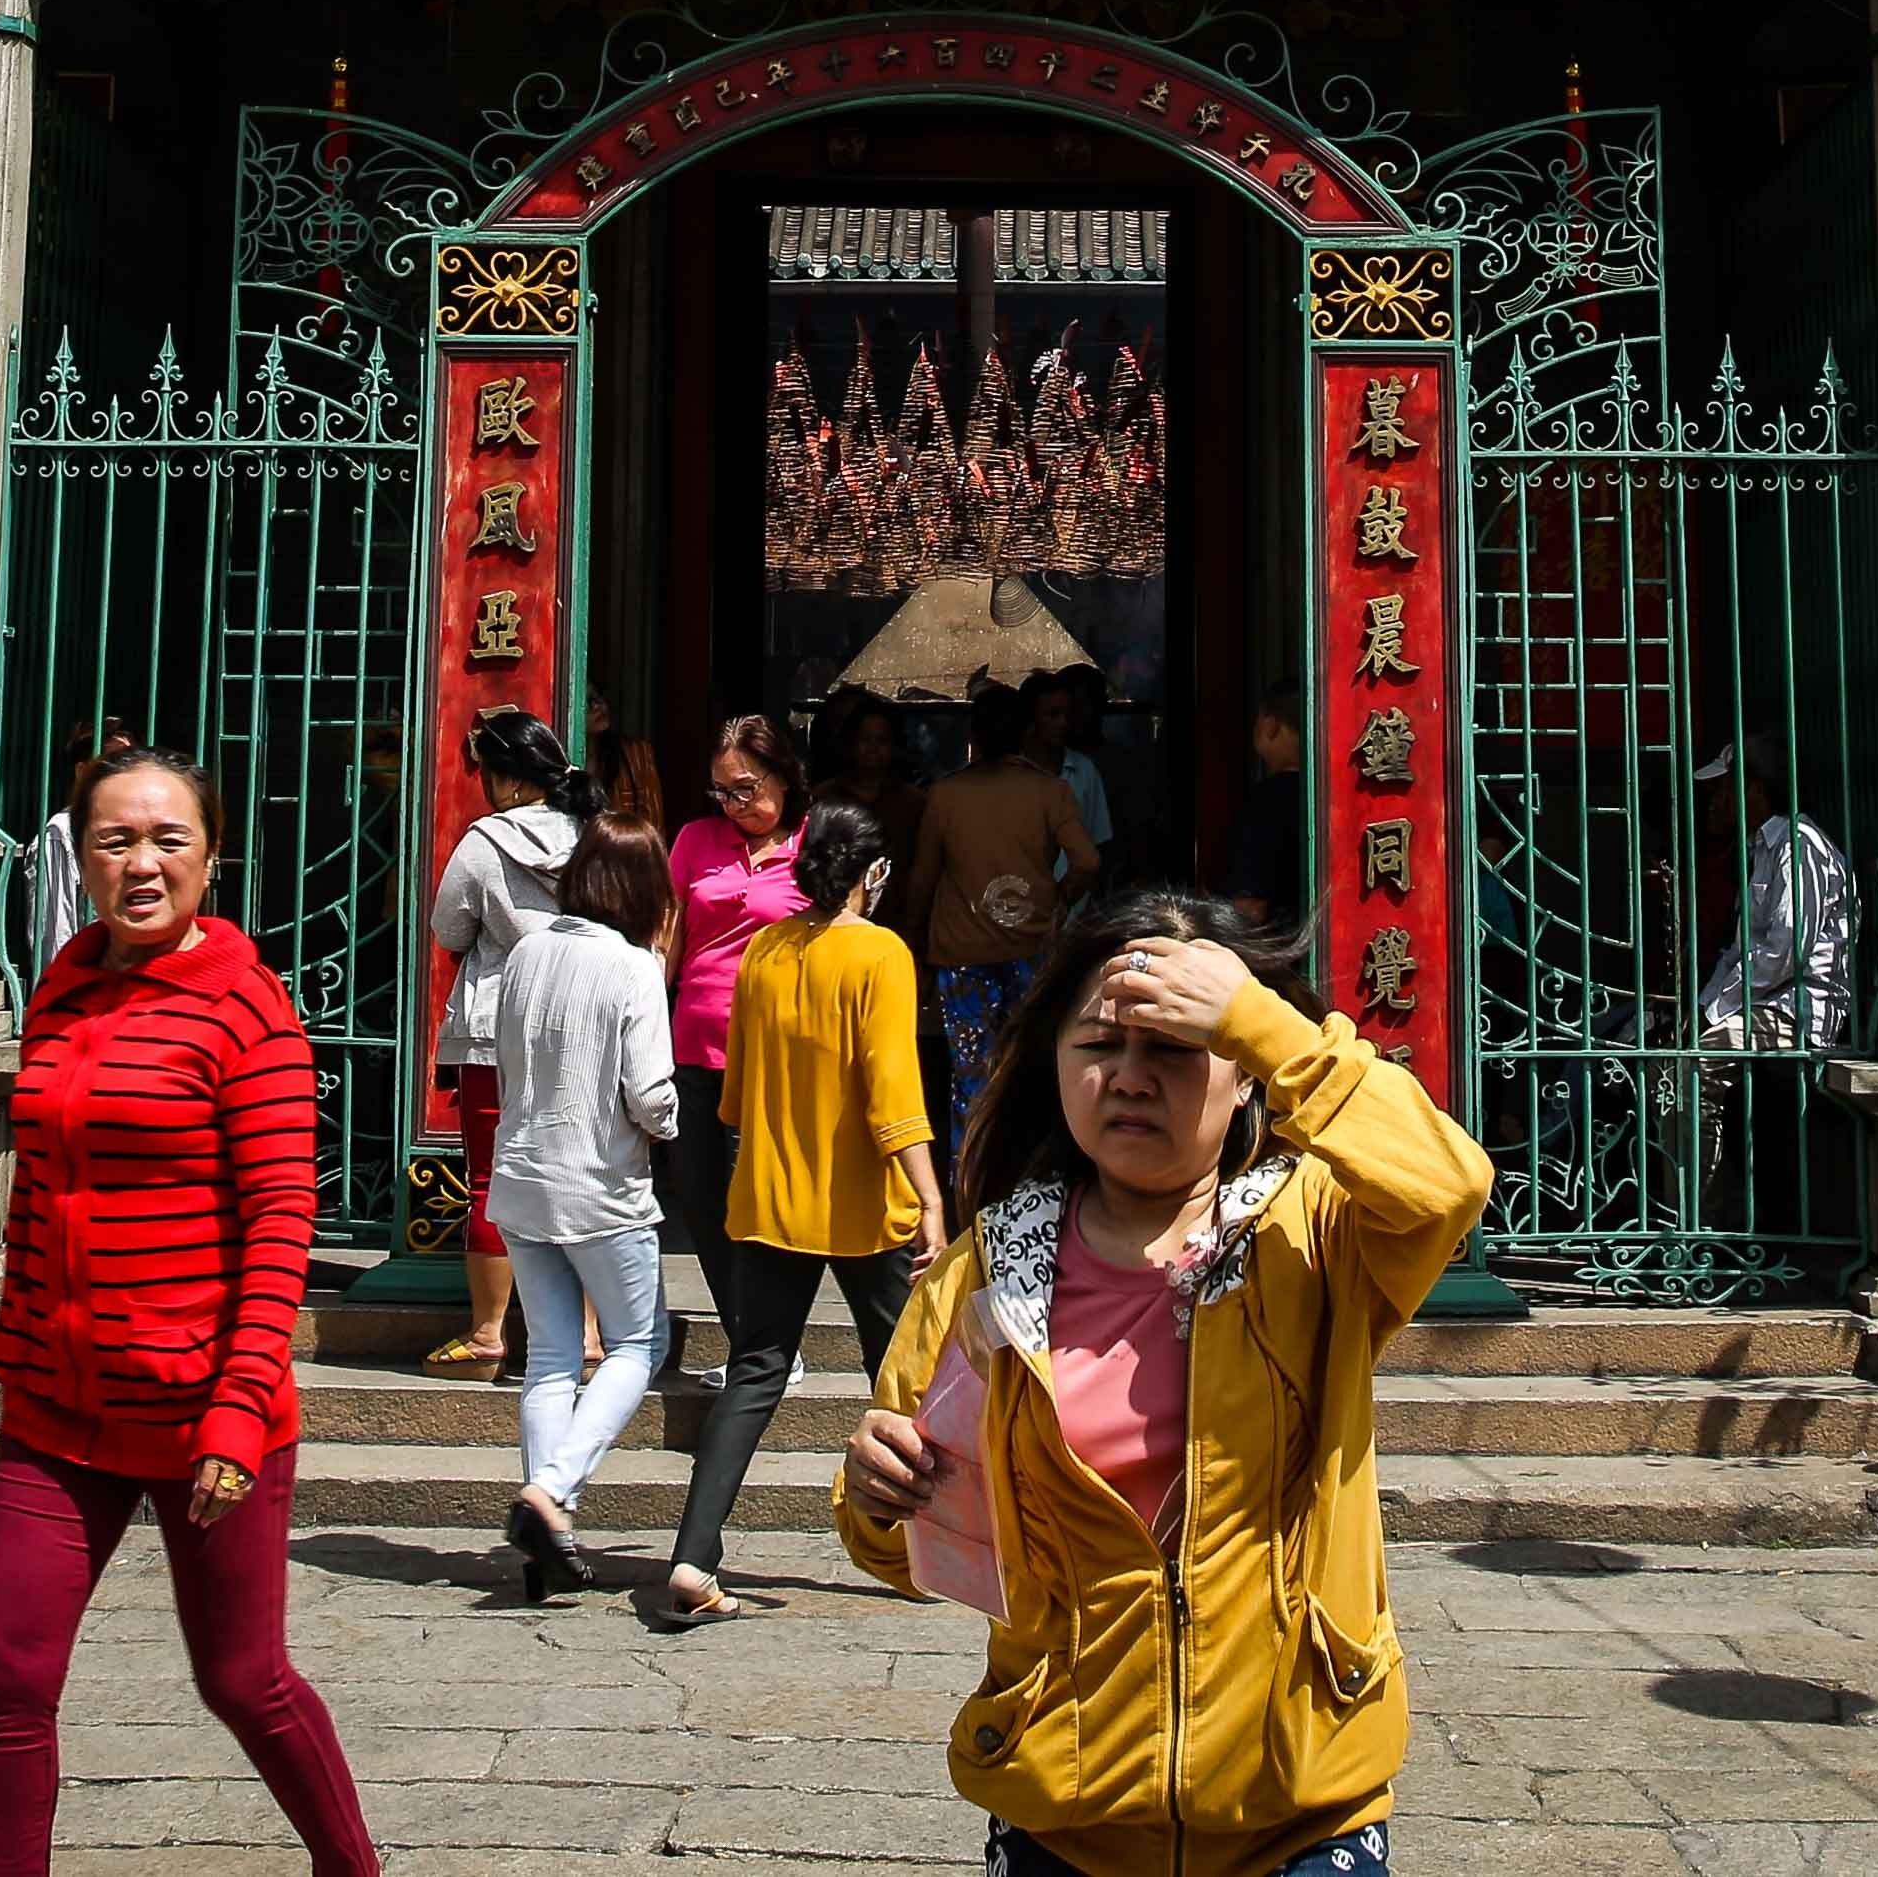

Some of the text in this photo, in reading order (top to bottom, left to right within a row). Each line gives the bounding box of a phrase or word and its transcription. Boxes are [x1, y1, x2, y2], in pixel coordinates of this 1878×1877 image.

[1350, 373, 1422, 1072] 暮鼓晨鐘同覺
